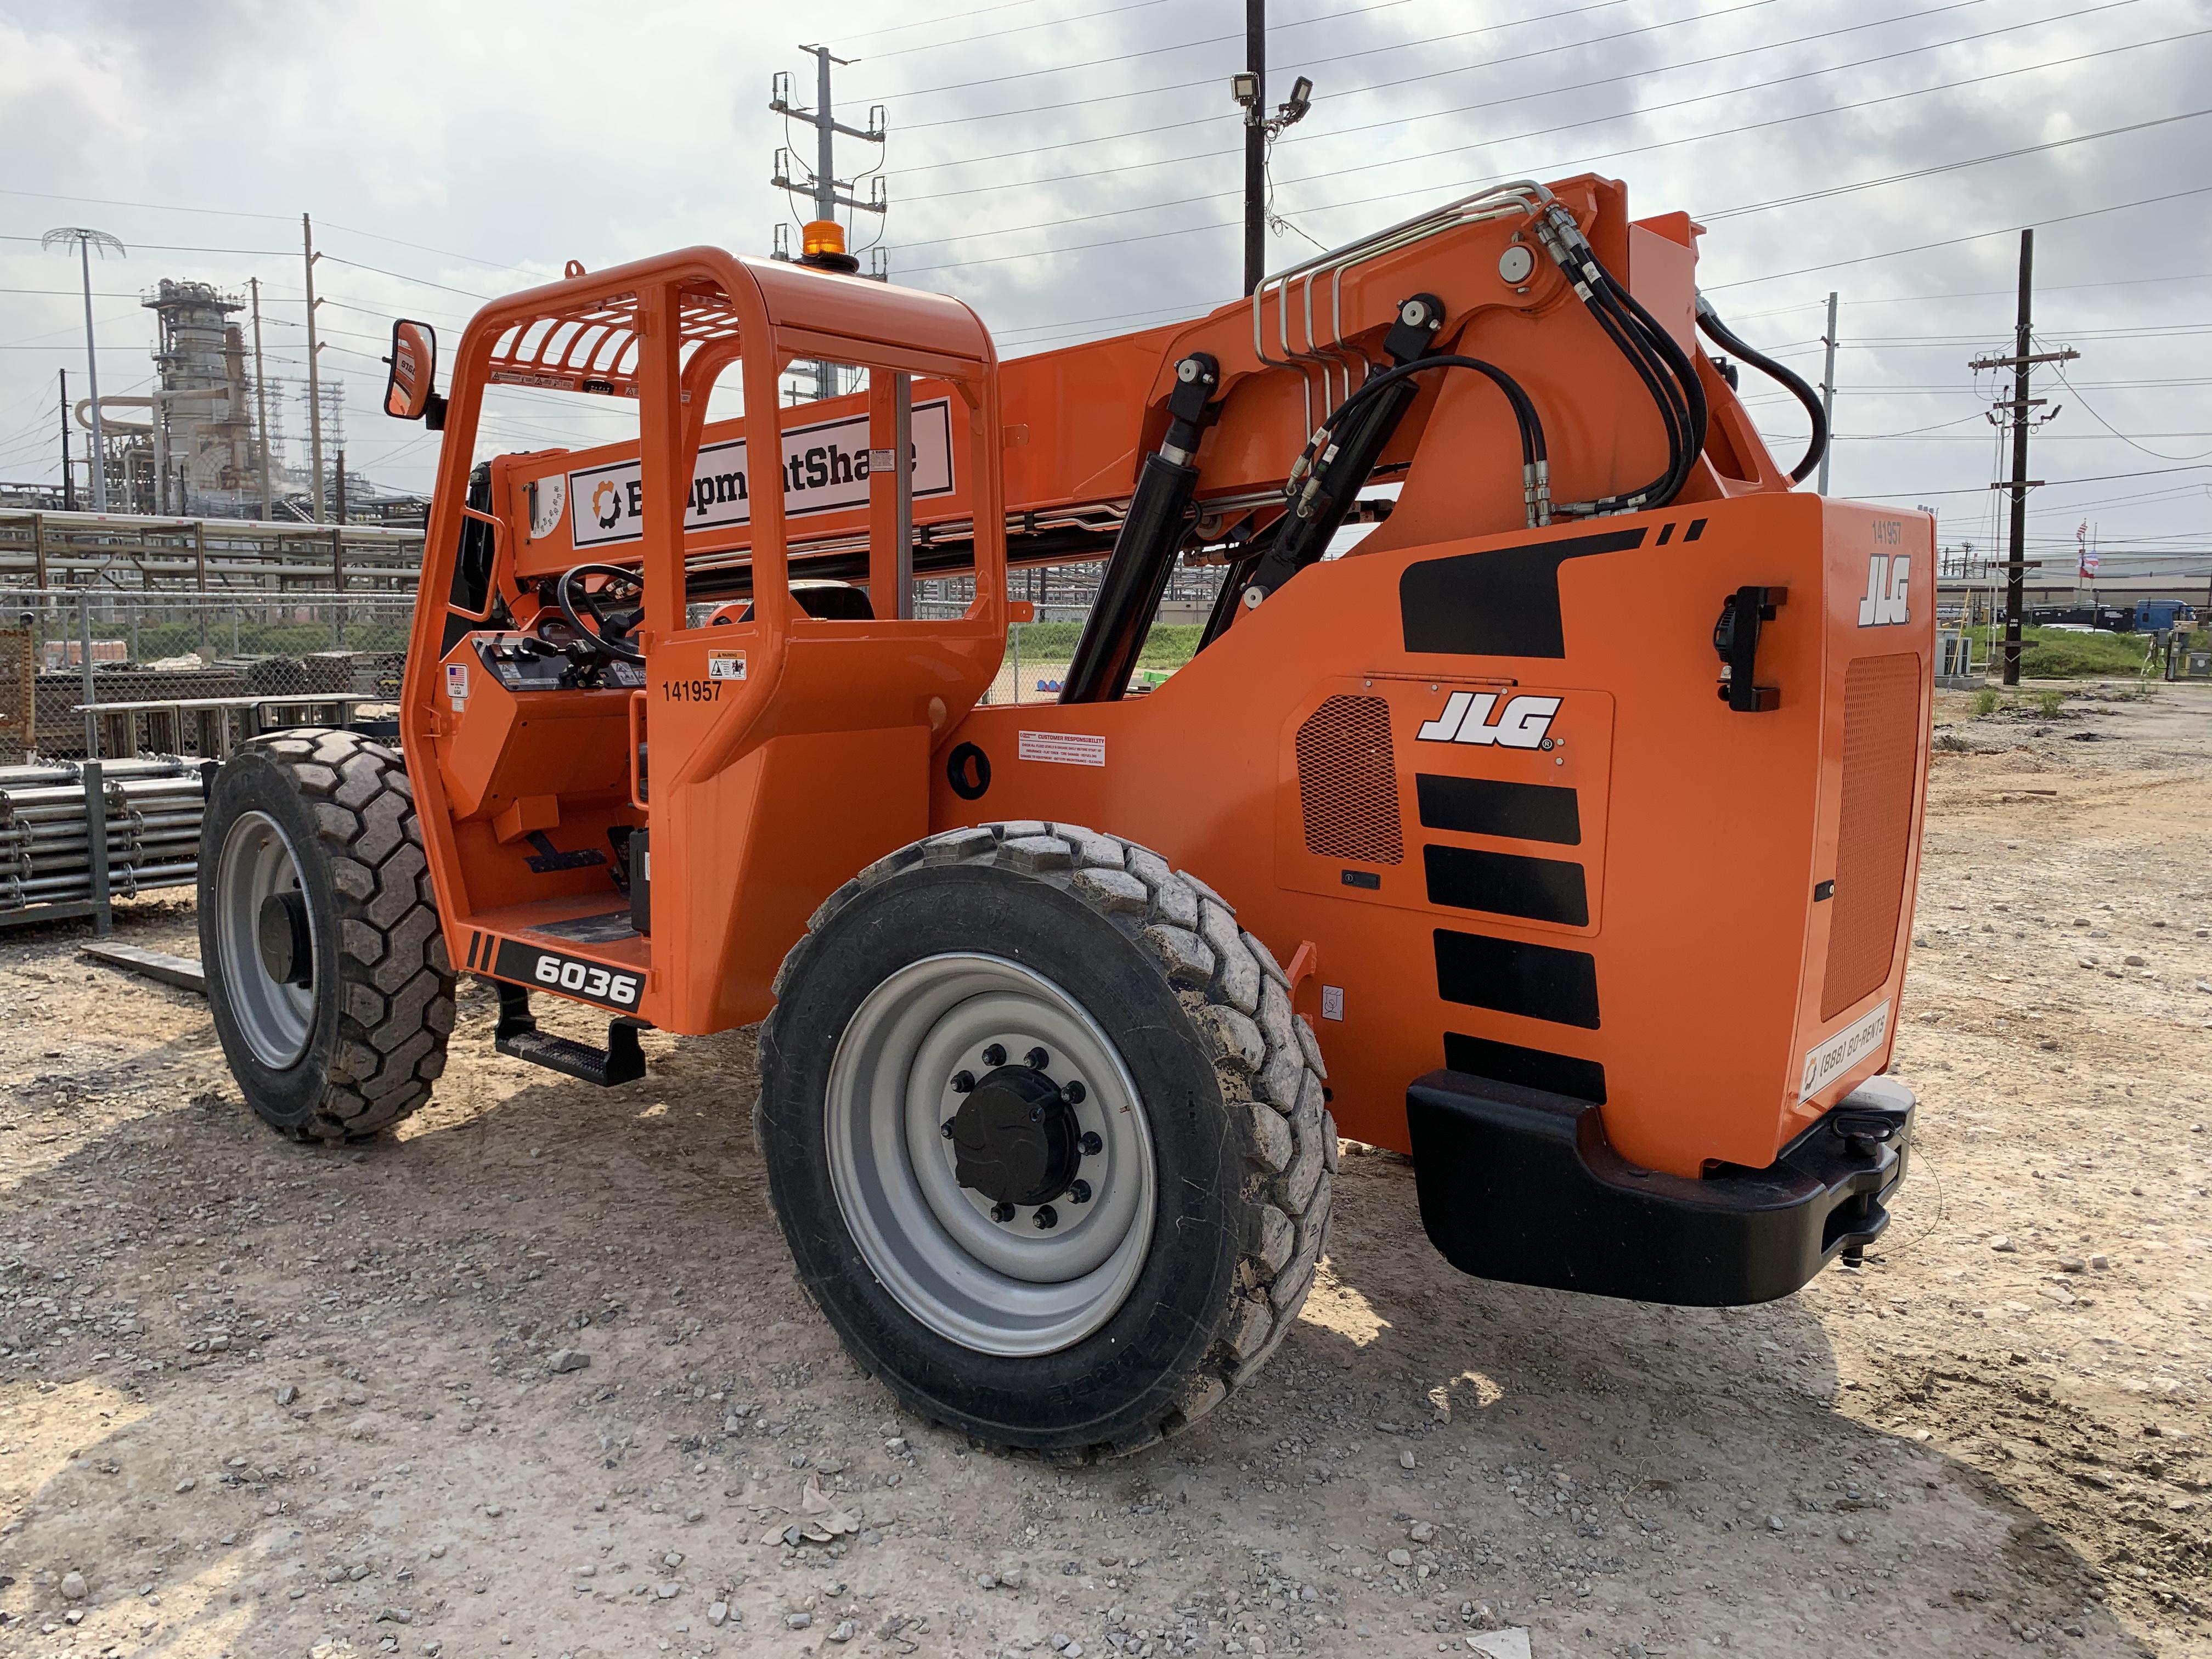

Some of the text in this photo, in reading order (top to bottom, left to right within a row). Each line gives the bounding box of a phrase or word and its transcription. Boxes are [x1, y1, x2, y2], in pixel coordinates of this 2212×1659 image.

[1872, 520, 1901, 545] 141957
[663, 680, 722, 702] 141957
[1064, 736, 1104, 744] RESPONSIBILITY
[535, 955, 637, 1004] 6036
[1820, 1015, 1885, 1077] (888) 80-RENTS
